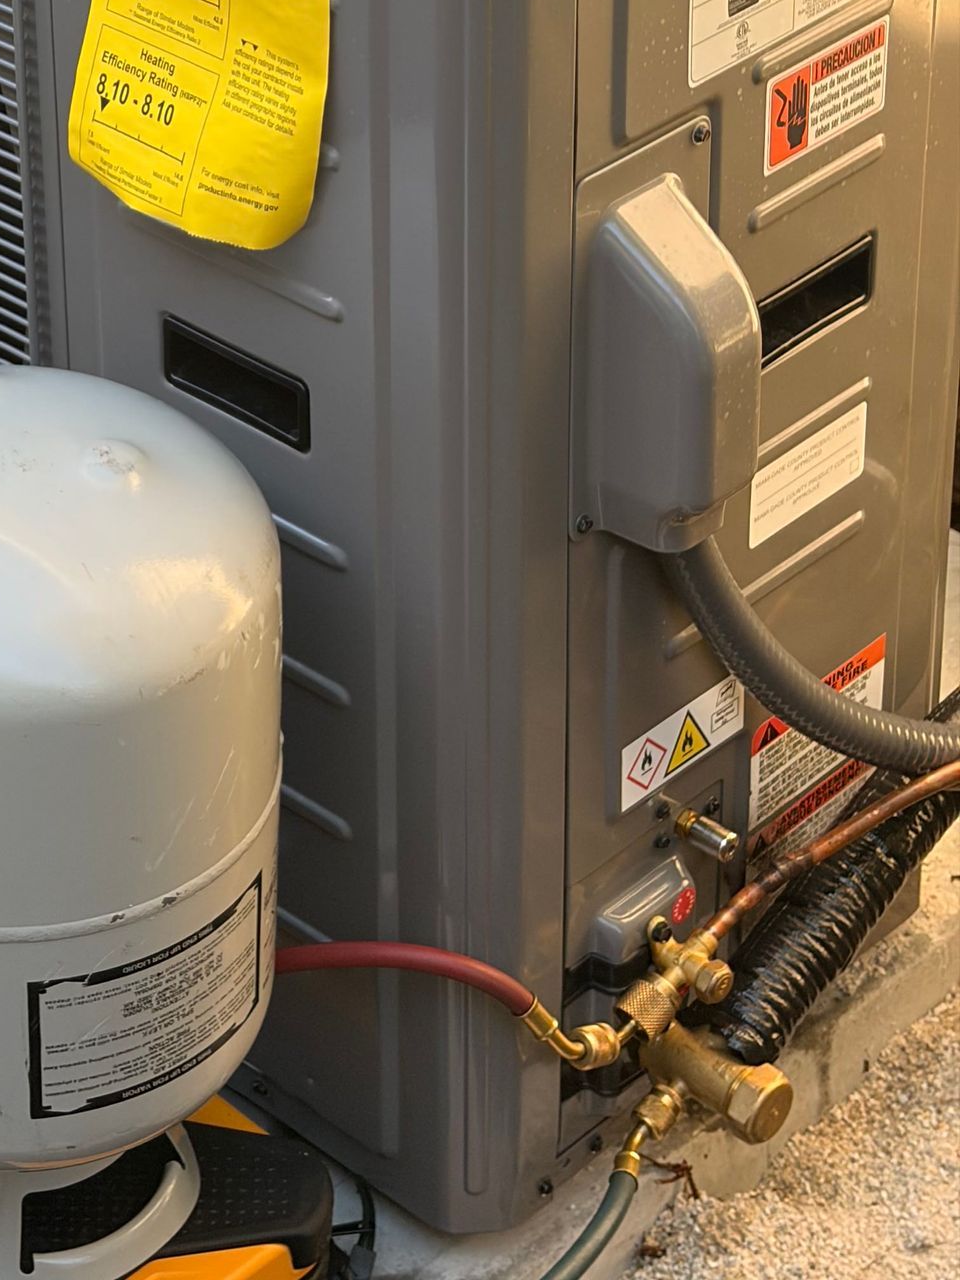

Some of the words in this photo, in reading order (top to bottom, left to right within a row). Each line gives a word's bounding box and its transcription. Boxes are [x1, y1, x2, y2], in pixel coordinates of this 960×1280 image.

[136, 2, 153, 17] Range
[153, 10, 159, 18] of
[140, 48, 176, 77] Heating
[266, 49, 276, 61] This
[821, 28, 876, 78] PRECAUCION
[101, 50, 147, 82] Efficiency
[148, 71, 179, 98] Rating
[233, 57, 241, 67] the
[241, 62, 251, 71] coil
[250, 67, 262, 76] your
[262, 71, 286, 87] contractor
[235, 48, 258, 64] efficiency
[257, 58, 275, 71] ratings
[275, 66, 295, 80] depend
[294, 74, 302, 82] on
[814, 83, 828, 96] Antes
[829, 77, 836, 89] de
[836, 70, 850, 85] tener
[850, 60, 868, 78] acceso
[873, 52, 881, 64] los
[96, 73, 130, 105] 8.10
[141, 93, 175, 126] 8.10
[228, 78, 250, 96] efficiency
[250, 89, 265, 102] rating
[262, 81, 272, 92] The
[272, 86, 290, 103] heating
[810, 90, 840, 113] dispositivos
[841, 75, 868, 96] terminales,
[869, 65, 883, 81] todos
[222, 98, 231, 109] Ask
[231, 104, 243, 114] your
[242, 109, 267, 125] contractor
[266, 118, 275, 128] for
[810, 115, 819, 127] los
[819, 102, 841, 123] circuitos
[842, 98, 849, 110] de
[815, 123, 830, 139] deben
[831, 117, 839, 128] ser
[201, 166, 211, 177] For
[211, 172, 234, 188] energy
[234, 180, 249, 191] cost
[266, 189, 280, 200] visit
[841, 658, 869, 688] FIRE
[170, 944, 181, 956] UP
[182, 935, 198, 949] END
[122, 958, 152, 975] LIQUID
[152, 950, 170, 964] FOR
[163, 1018, 176, 1030] OR
[148, 1035, 175, 1052] ACTION
[153, 1063, 168, 1075] AID
[168, 1053, 188, 1070] FIRST
[152, 1074, 170, 1088] FOR
[170, 1068, 181, 1079] UP
[121, 1083, 152, 1099] VAPOR
